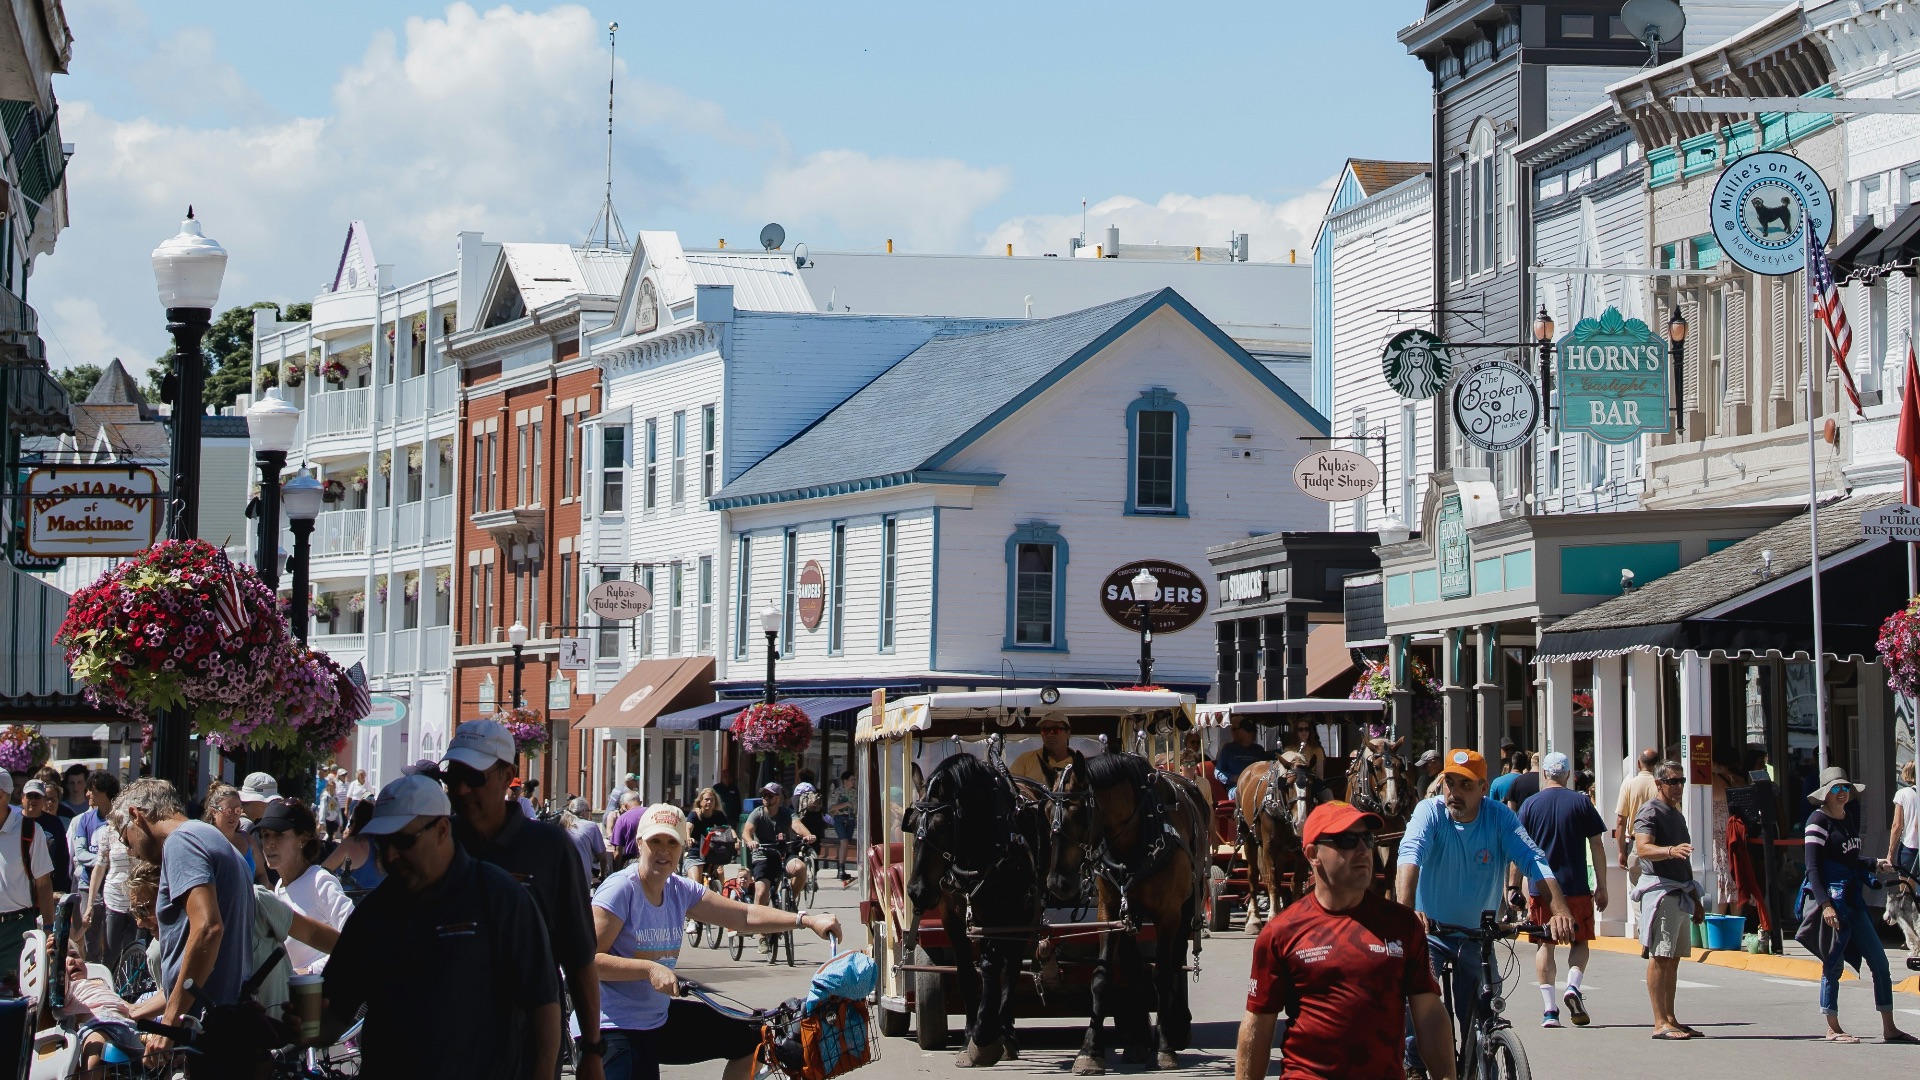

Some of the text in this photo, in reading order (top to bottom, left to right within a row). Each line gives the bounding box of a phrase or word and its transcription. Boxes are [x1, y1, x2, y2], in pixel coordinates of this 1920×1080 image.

[1719, 163, 1821, 211] Millie's on Main
[1731, 235, 1794, 266] homestyle
[1566, 345, 1659, 371] HORN'S
[1480, 371, 1499, 385] The
[1461, 376, 1523, 411] Broken
[1471, 396, 1528, 445] Spoke
[1589, 400, 1641, 426] BAR
[1318, 455, 1356, 475] Ryba's
[1300, 472, 1374, 492] Fudge Shops
[34, 481, 149, 515] BENJAMIN
[84, 502, 98, 512] of
[46, 516, 134, 532] Mackinac
[606, 585, 636, 600] Ryba's
[799, 583, 821, 599] SANDERS
[1107, 584, 1202, 603] SADERS
[593, 597, 648, 612] Fudge Shops
